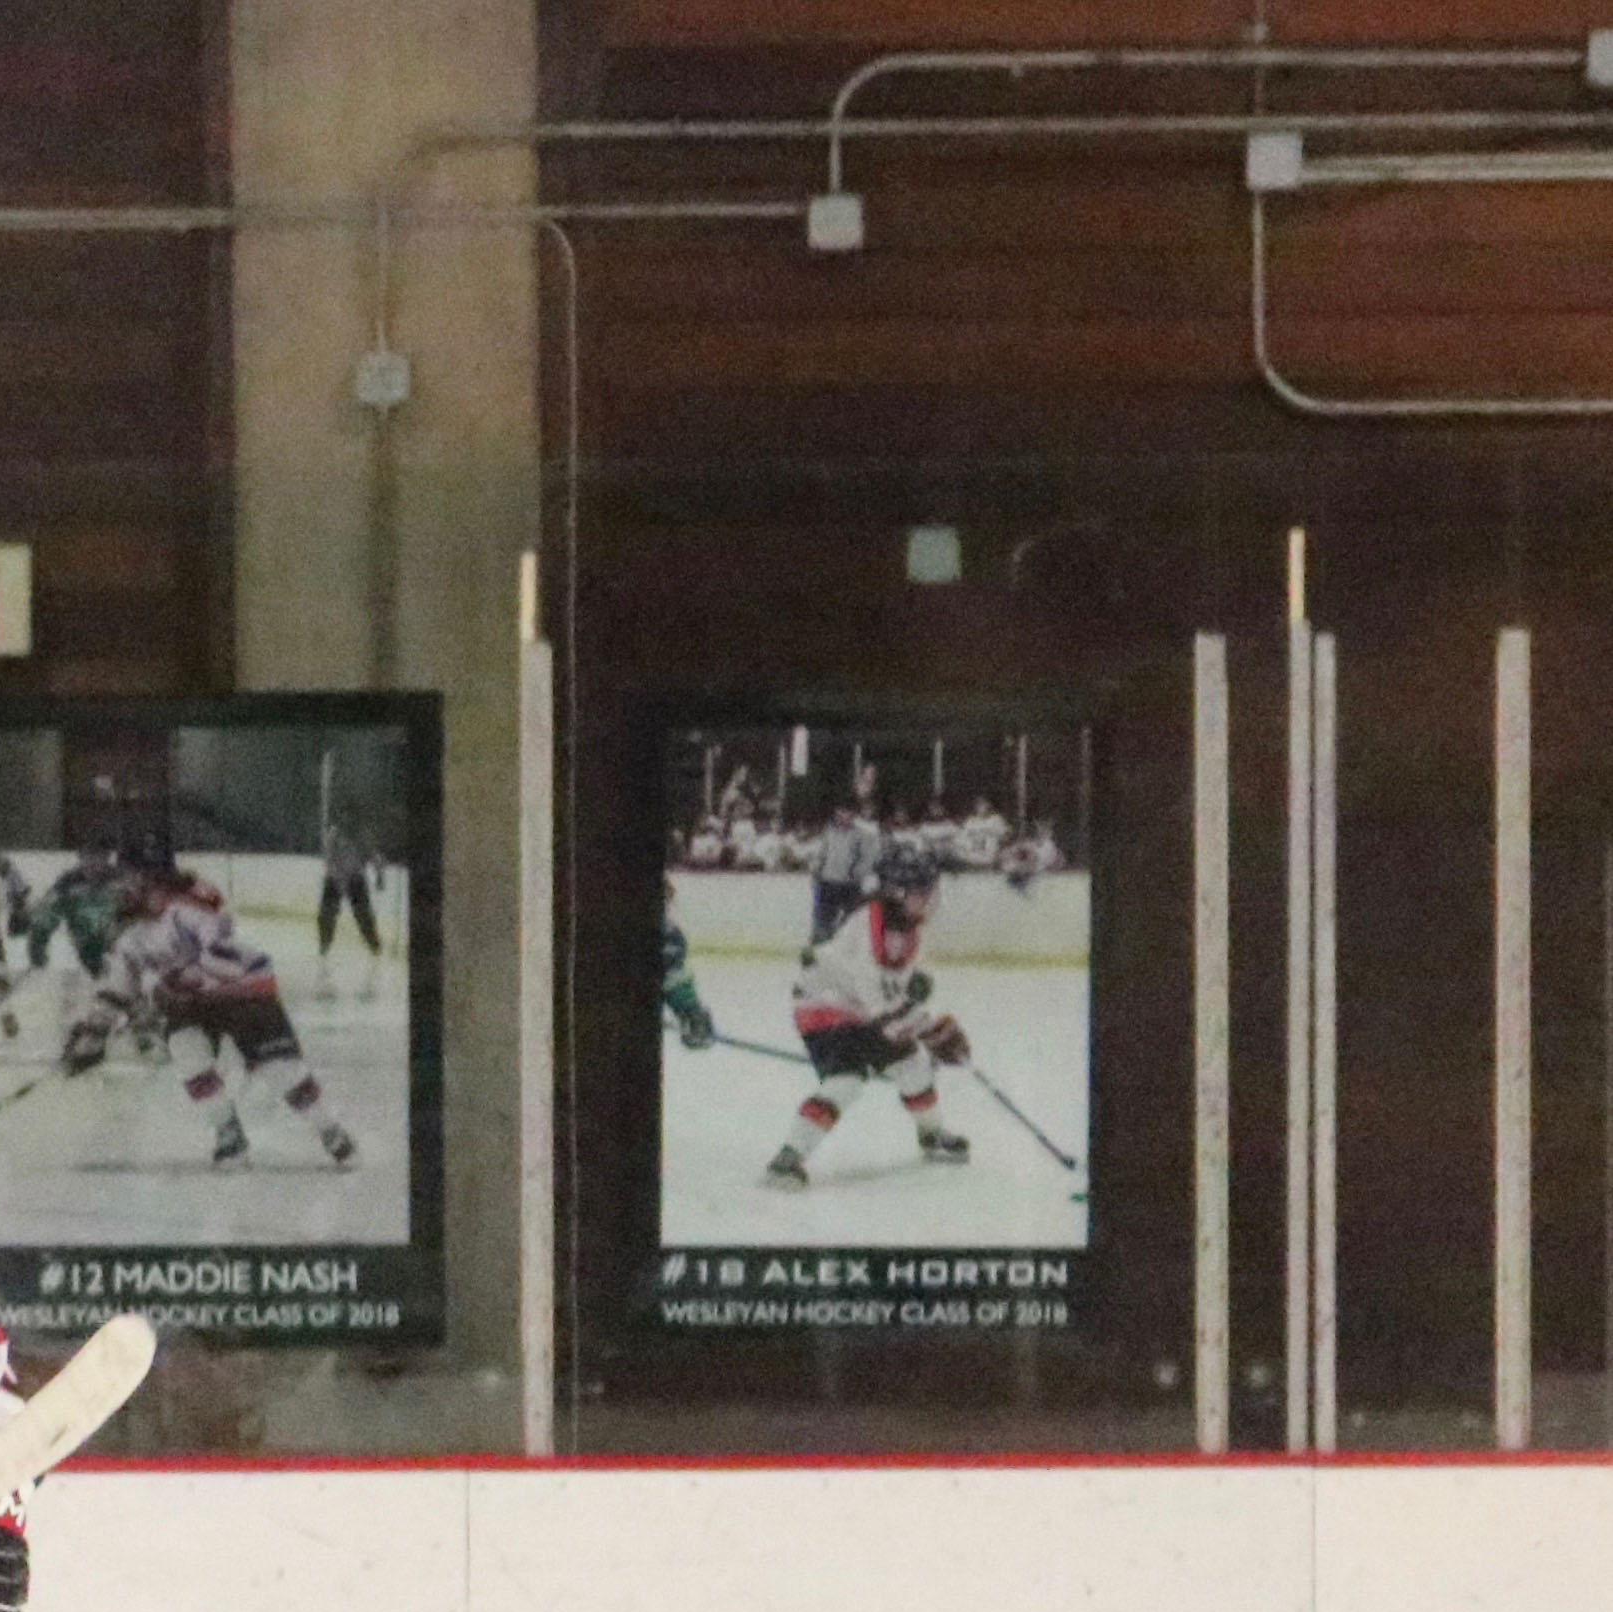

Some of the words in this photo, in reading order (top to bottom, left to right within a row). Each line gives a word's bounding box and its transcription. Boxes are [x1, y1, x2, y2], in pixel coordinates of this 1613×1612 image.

[39, 1261, 105, 1294] #12
[113, 1261, 253, 1294] MADDIE
[261, 1261, 359, 1293] NASH
[663, 1254, 745, 1287] #18
[762, 1259, 871, 1287] ALEX
[887, 1259, 1068, 1287] HORTON
[234, 1303, 303, 1328] CLASS
[309, 1303, 341, 1328] OF
[349, 1303, 400, 1328] 2018
[662, 1301, 788, 1326] WESLEYAN
[793, 1301, 894, 1326] HOCKEY
[900, 1301, 971, 1326] CLASS
[976, 1301, 1007, 1326] OF
